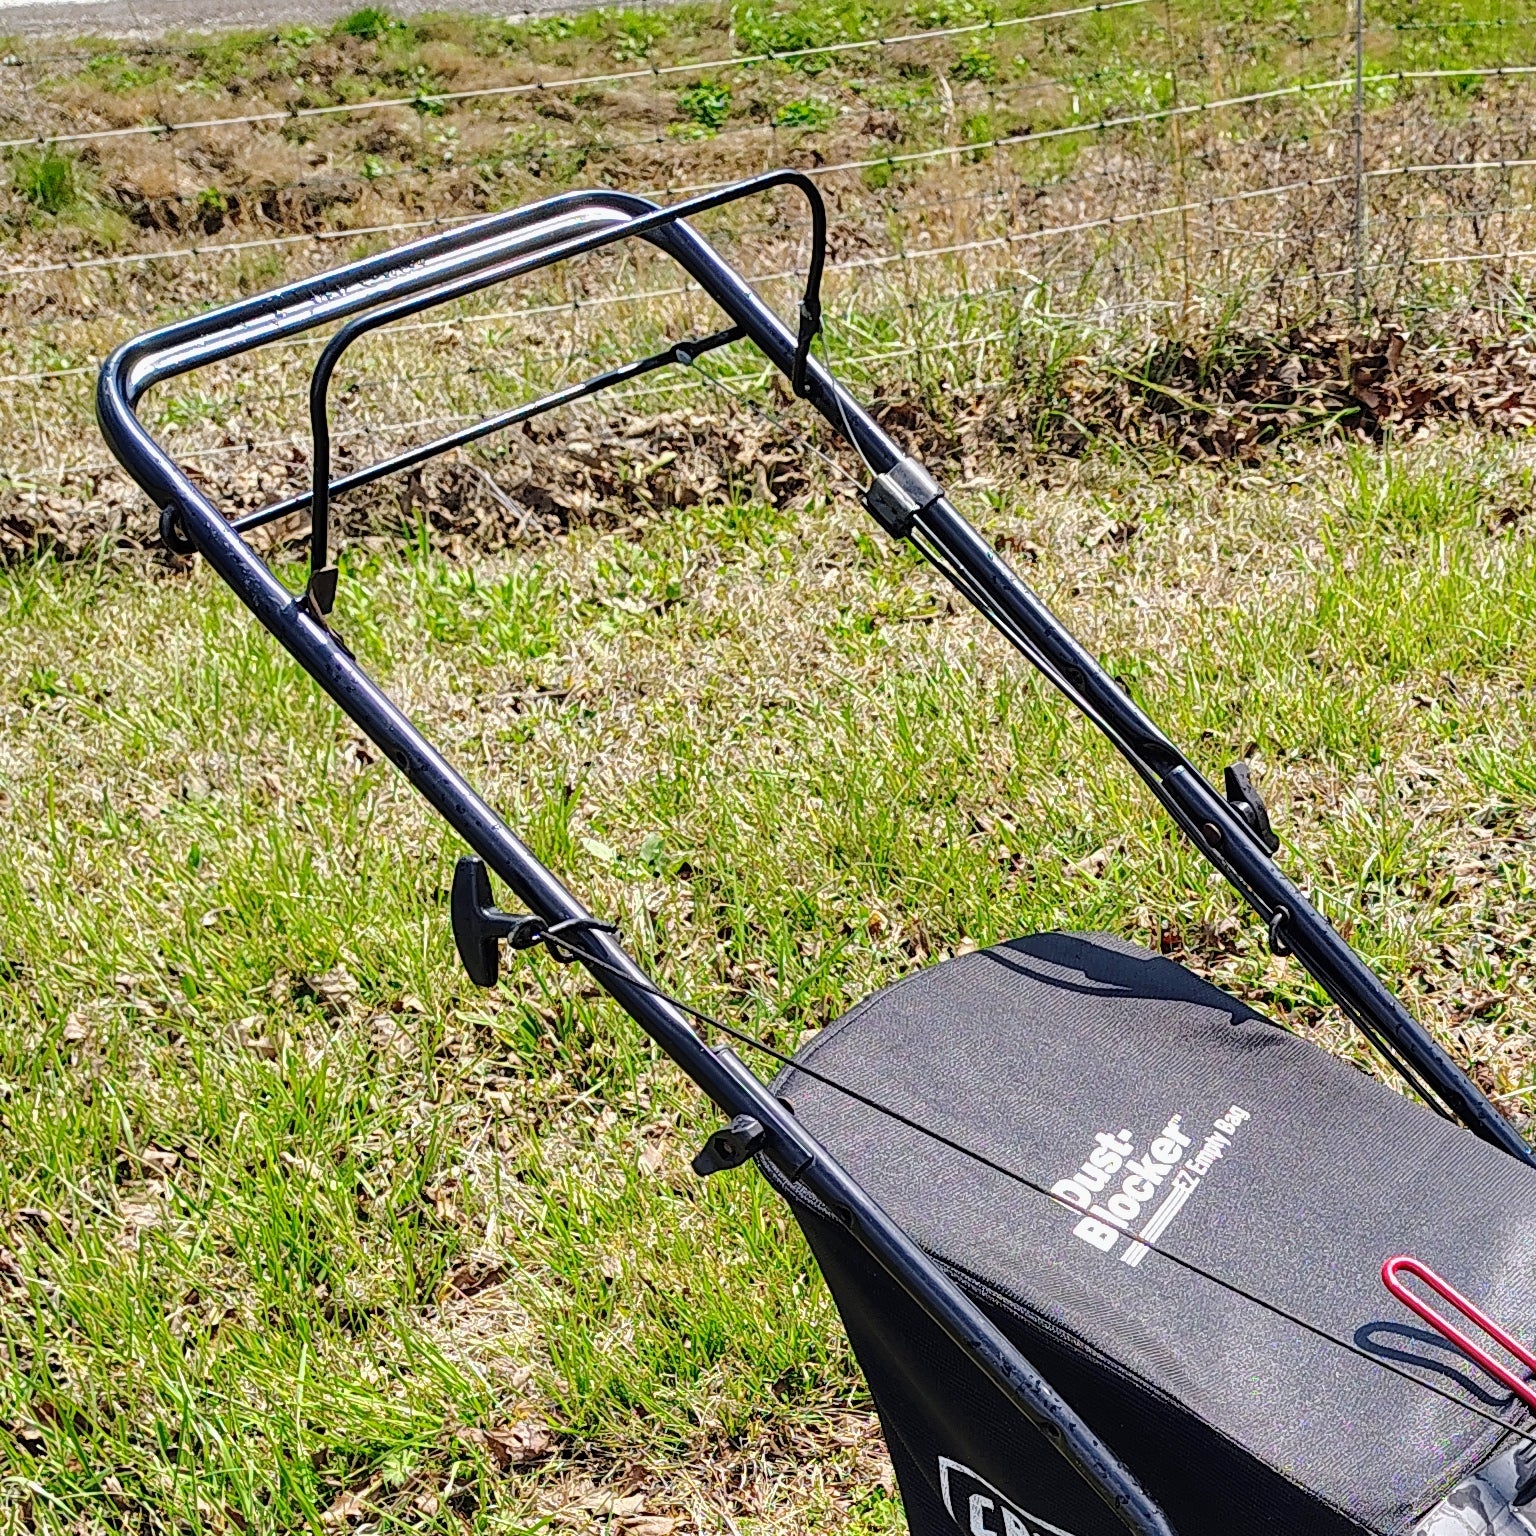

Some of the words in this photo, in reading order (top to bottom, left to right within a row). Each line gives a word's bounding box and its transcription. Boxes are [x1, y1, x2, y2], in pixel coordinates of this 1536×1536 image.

[1213, 1104, 1251, 1136] Bag
[1185, 1131, 1232, 1176] Empty
[1172, 1168, 1200, 1194] EZ
